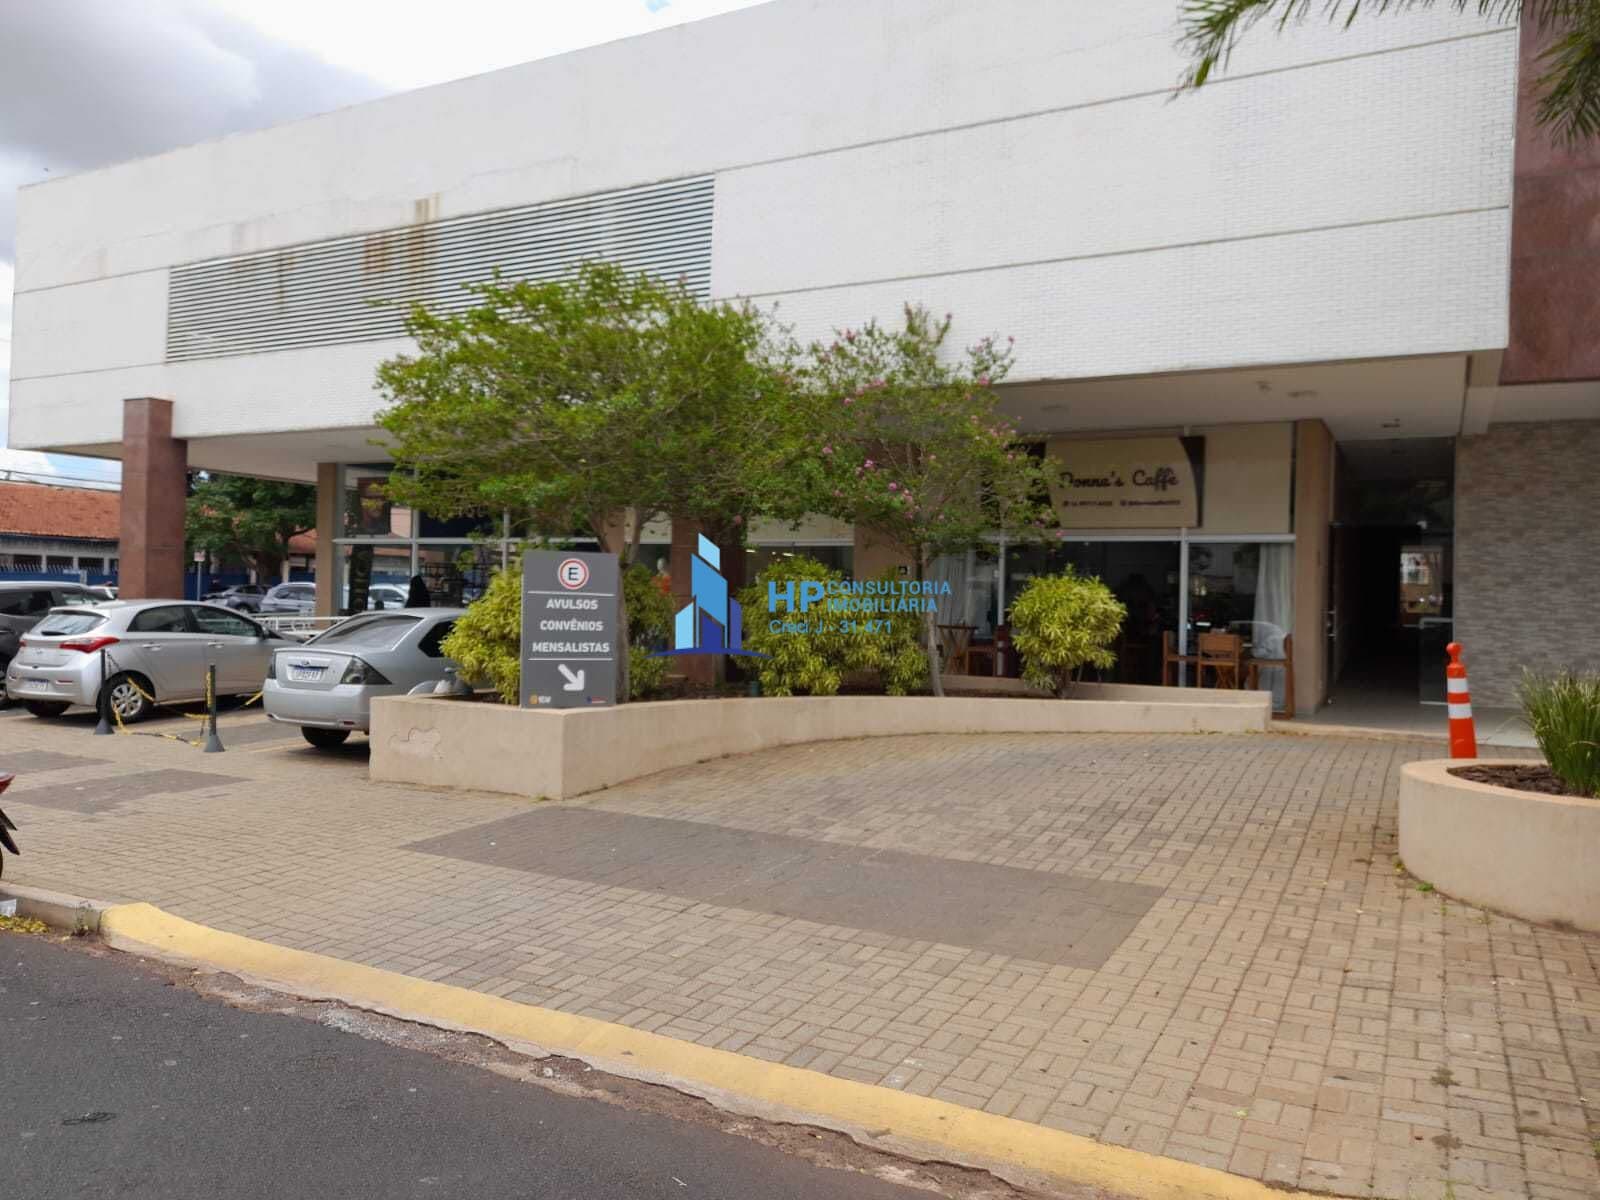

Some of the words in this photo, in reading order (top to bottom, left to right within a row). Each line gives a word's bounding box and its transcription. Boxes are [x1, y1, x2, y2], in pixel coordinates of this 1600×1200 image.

[568, 567, 579, 581] E
[546, 598, 598, 610] AVULSOS
[540, 618, 604, 631] CONVÊNIOS
[532, 642, 610, 653] MENSALISTAS
